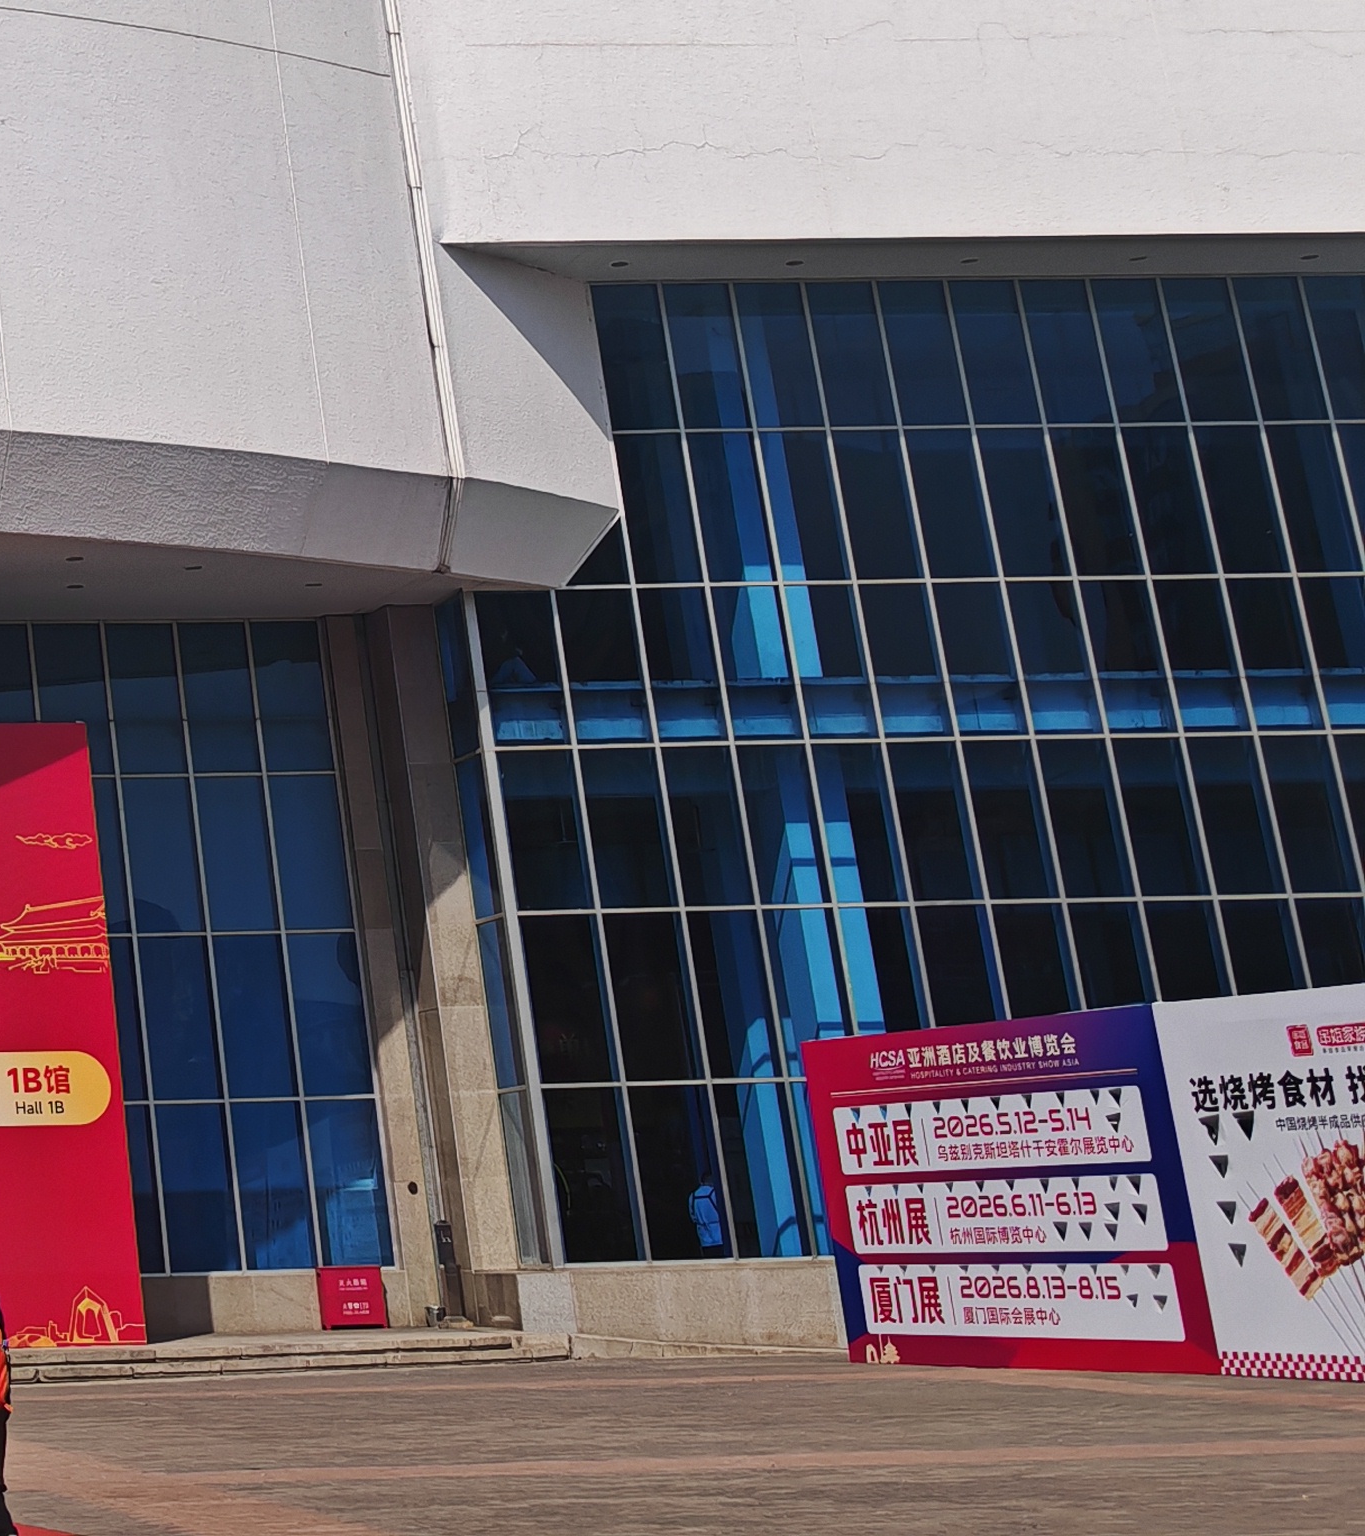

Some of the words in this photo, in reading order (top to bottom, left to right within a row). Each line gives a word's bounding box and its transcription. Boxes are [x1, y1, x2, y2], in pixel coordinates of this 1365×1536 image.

[870, 1049, 906, 1069] HCSA
[906, 1032, 1076, 1069] 亚洲酒店及餐饮业博览会
[6, 1065, 71, 1096] 1B馆
[910, 1069, 954, 1080] HOSPITALITY
[963, 1065, 999, 1076] CATERING
[1000, 1061, 1036, 1073] INDUSTRY
[1038, 1059, 1060, 1070] SHOW
[1189, 1068, 1336, 1113] 选烧烤食材
[15, 1100, 43, 1116] Hall
[48, 1100, 65, 1115] 1B
[933, 1107, 1092, 1139] 2026.5.12-5.14
[845, 1120, 919, 1168] 中亚展
[937, 1134, 1134, 1162] 乌兹别克斯坦塔什干安霍尔展览中心
[946, 1192, 1097, 1219] 2026.6.11-6.13
[856, 1197, 932, 1246] 杭州展
[949, 1225, 1047, 1245] 杭州国际博览中心
[869, 1276, 946, 1325] 厦门展
[959, 1275, 1121, 1301] 2026.8.13-8.15
[963, 1306, 1061, 1326] 厦门国际会展中心
